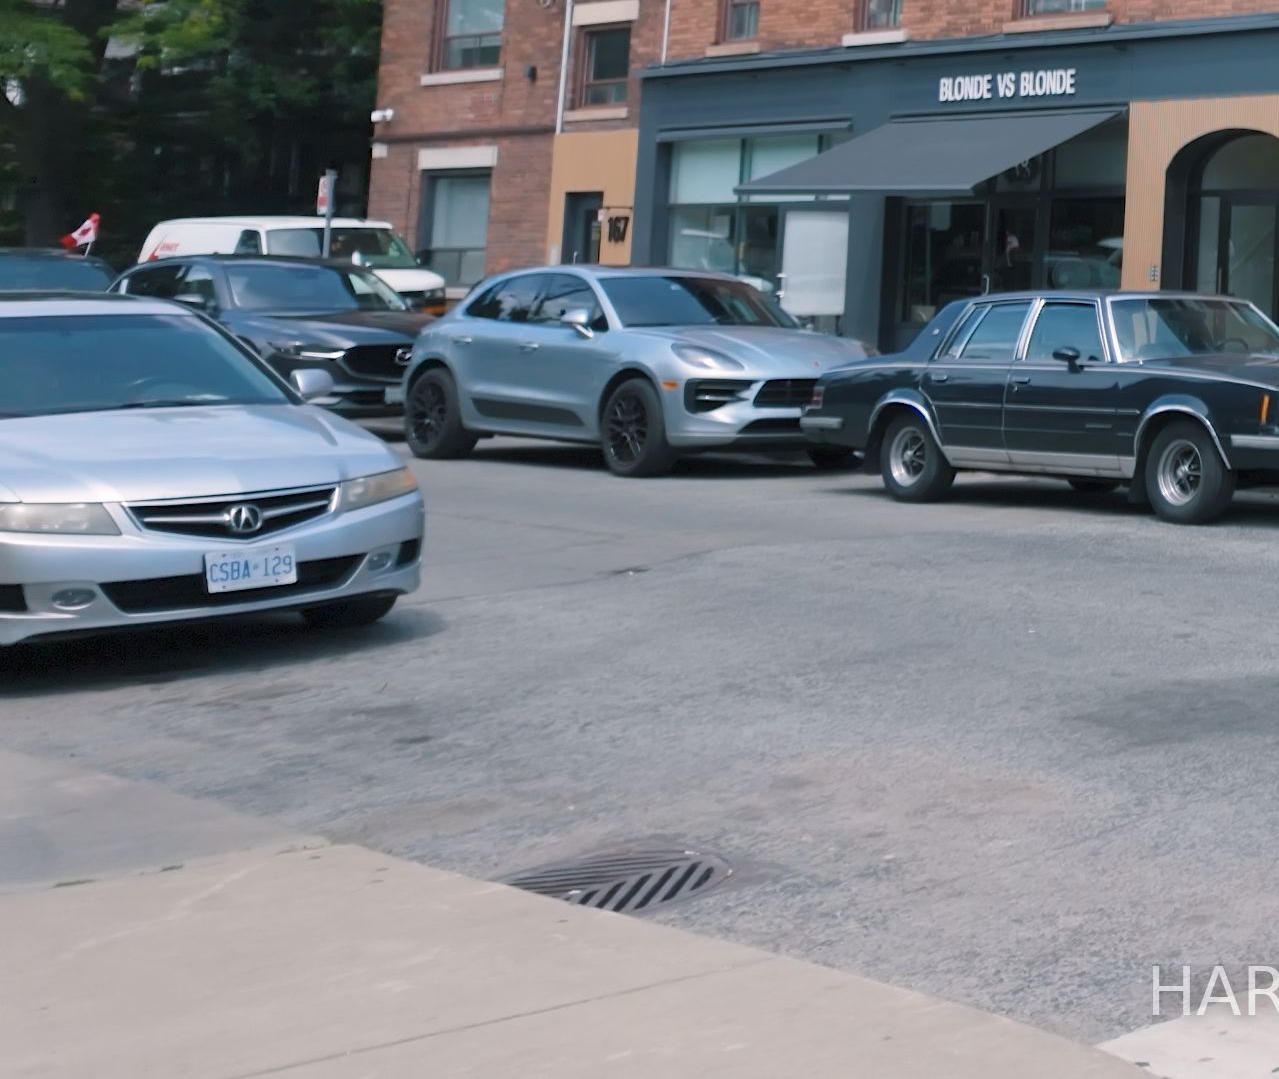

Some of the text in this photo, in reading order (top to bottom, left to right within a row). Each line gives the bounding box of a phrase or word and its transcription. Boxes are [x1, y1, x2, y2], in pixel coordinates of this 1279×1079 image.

[939, 68, 1076, 102] BLONDE VS BLONDE
[608, 216, 629, 243] 167
[210, 555, 293, 583] CSBA 129
